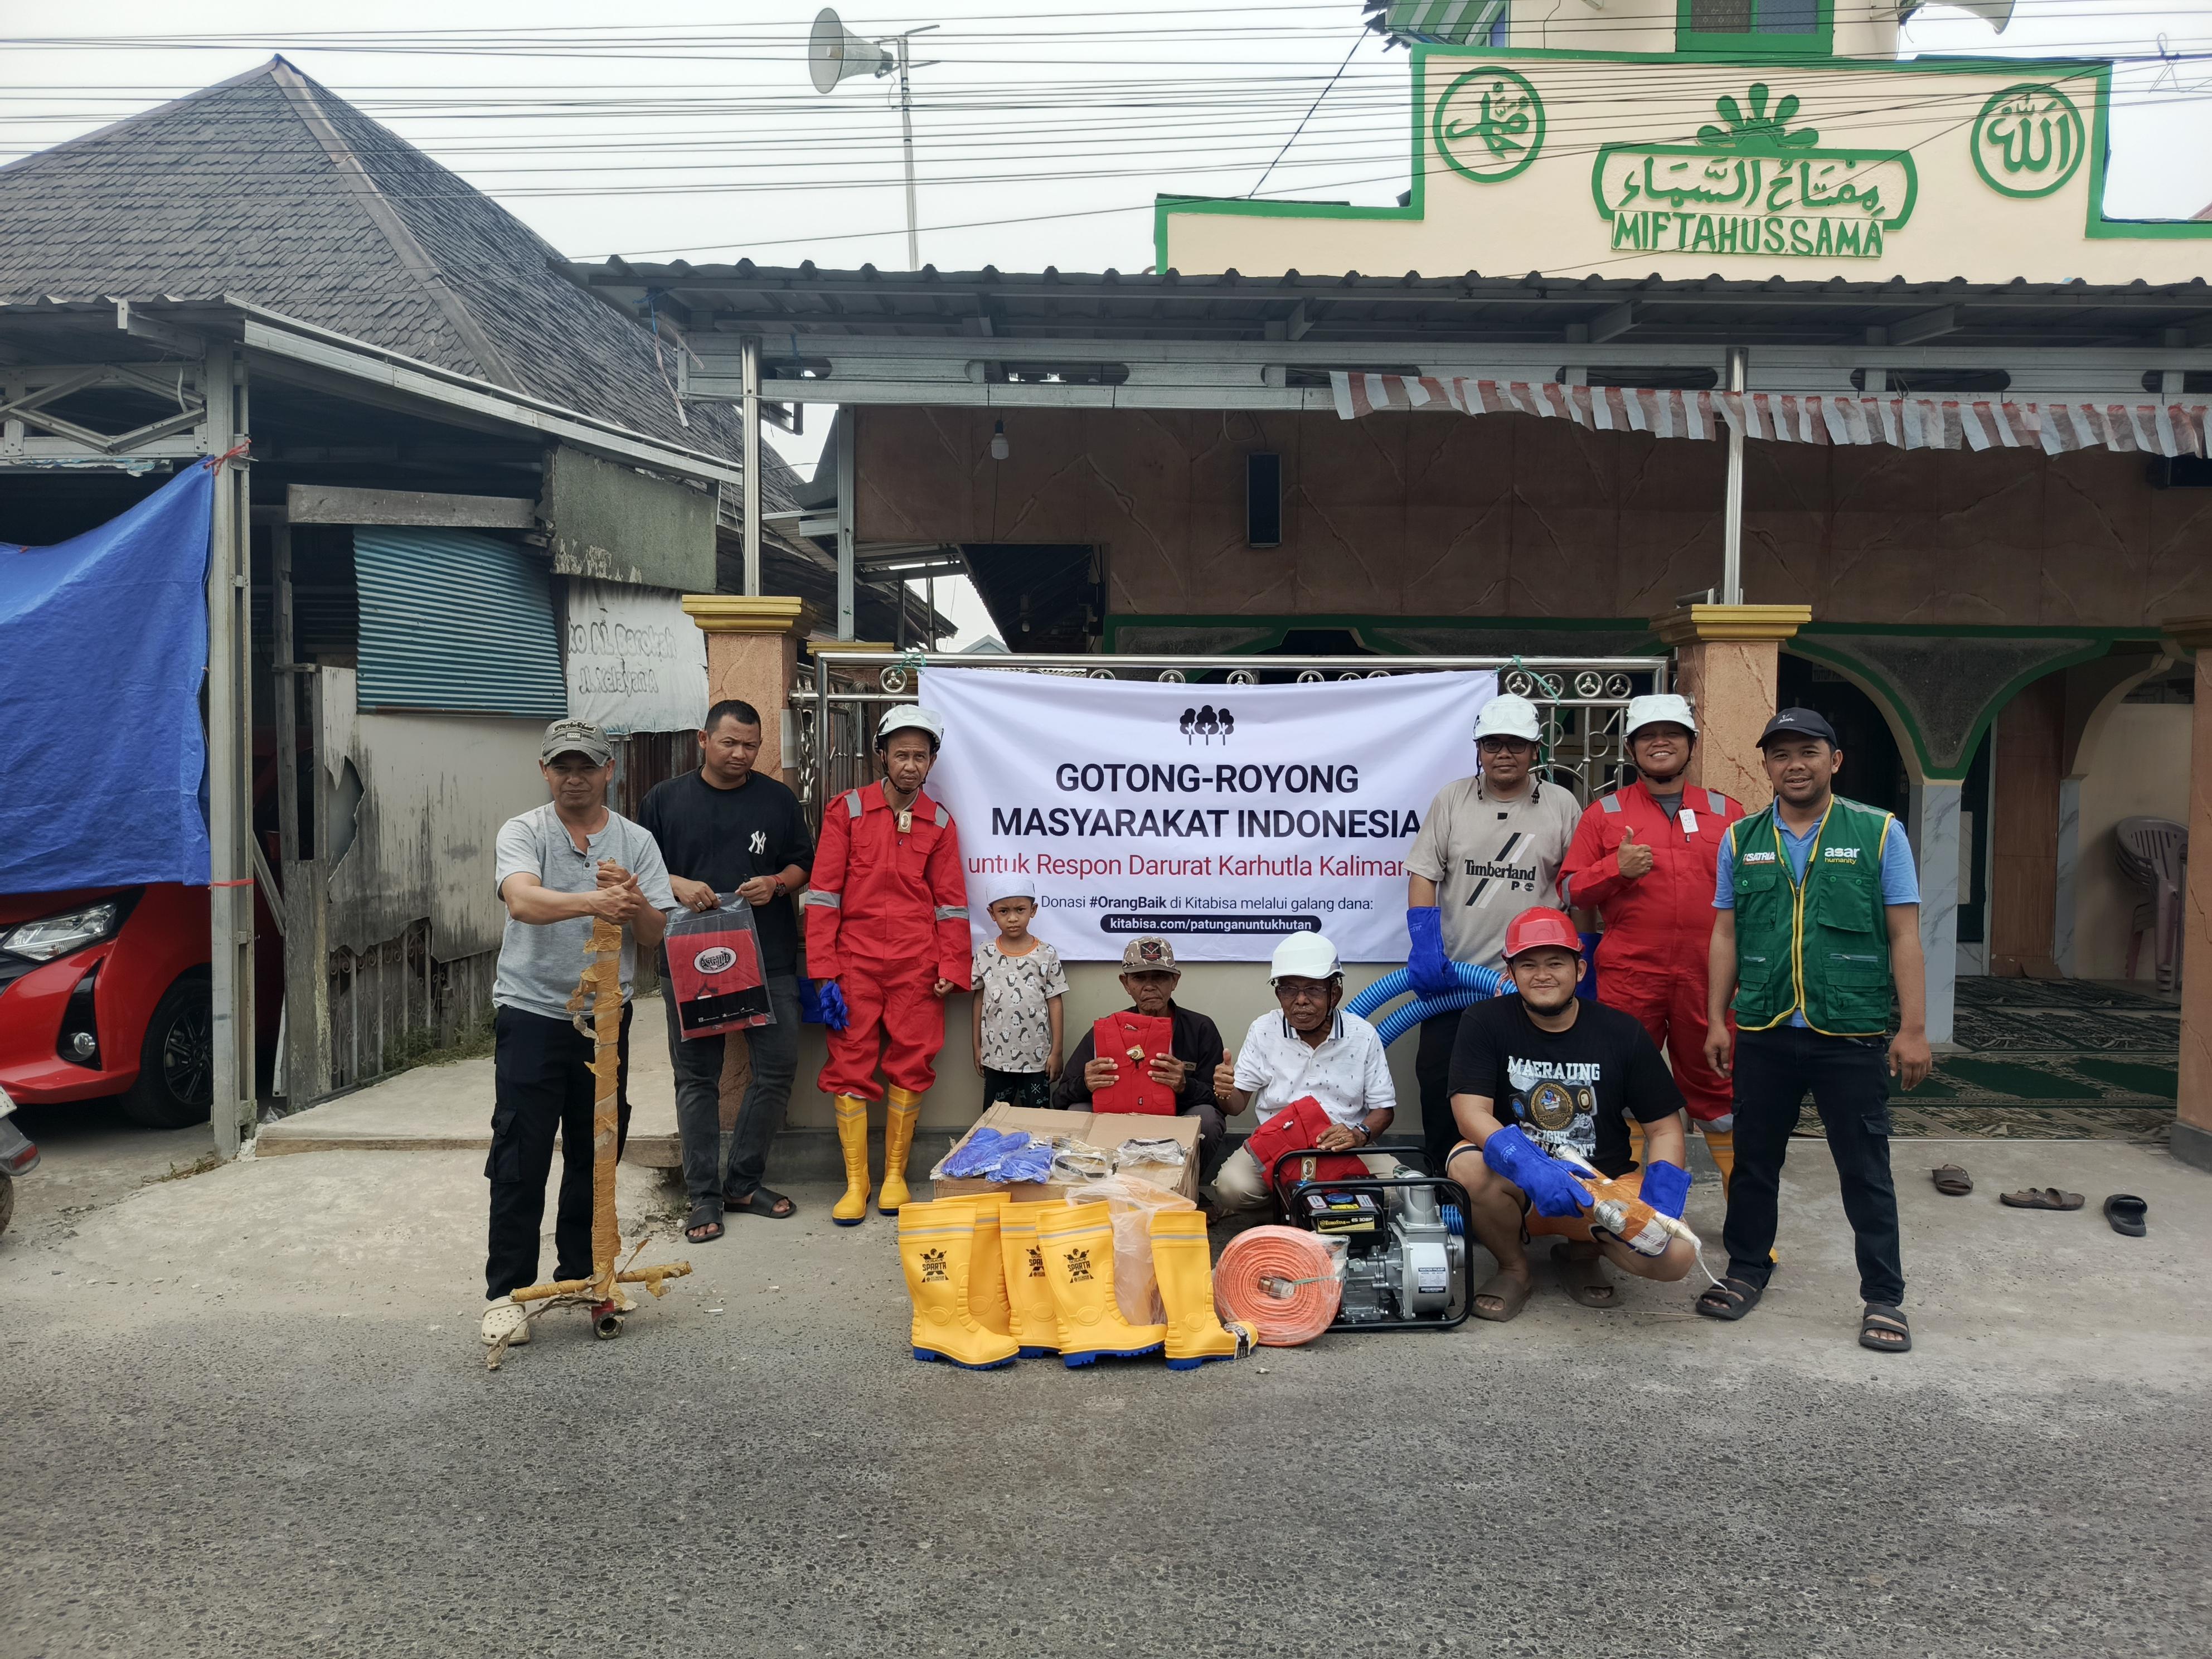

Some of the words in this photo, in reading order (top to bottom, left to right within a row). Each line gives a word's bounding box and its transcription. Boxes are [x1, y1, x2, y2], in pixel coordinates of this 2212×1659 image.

[1613, 212, 1883, 256] MIFTAHUSSAMA
[1056, 763, 1359, 793] GOTONG-ROYONG
[992, 807, 1229, 837] MASYARAKAT
[1238, 809, 1420, 838] INDONESIA
[1824, 847, 1860, 858] asar
[968, 853, 1030, 874] untuk
[1037, 853, 1121, 880] Respon
[1129, 855, 1212, 876] Darurat
[1219, 855, 1312, 876] Karhutla
[1464, 859, 1536, 881] Timberland
[1041, 895, 1086, 908] Donasi
[1089, 896, 1167, 911] #OrangBaik
[1170, 896, 1182, 909] di
[1185, 896, 1237, 909] Kitabisa
[1241, 896, 1288, 910] melalui
[1291, 897, 1335, 912] galang
[1338, 897, 1374, 910] dana:
[1110, 918, 1312, 932] kitabisa.com/patunganuntukhutan
[1507, 1055, 1600, 1080] MAERAUNG
[922, 1262, 947, 1272] SPARTA
[1068, 1261, 1091, 1272] SPARTA
